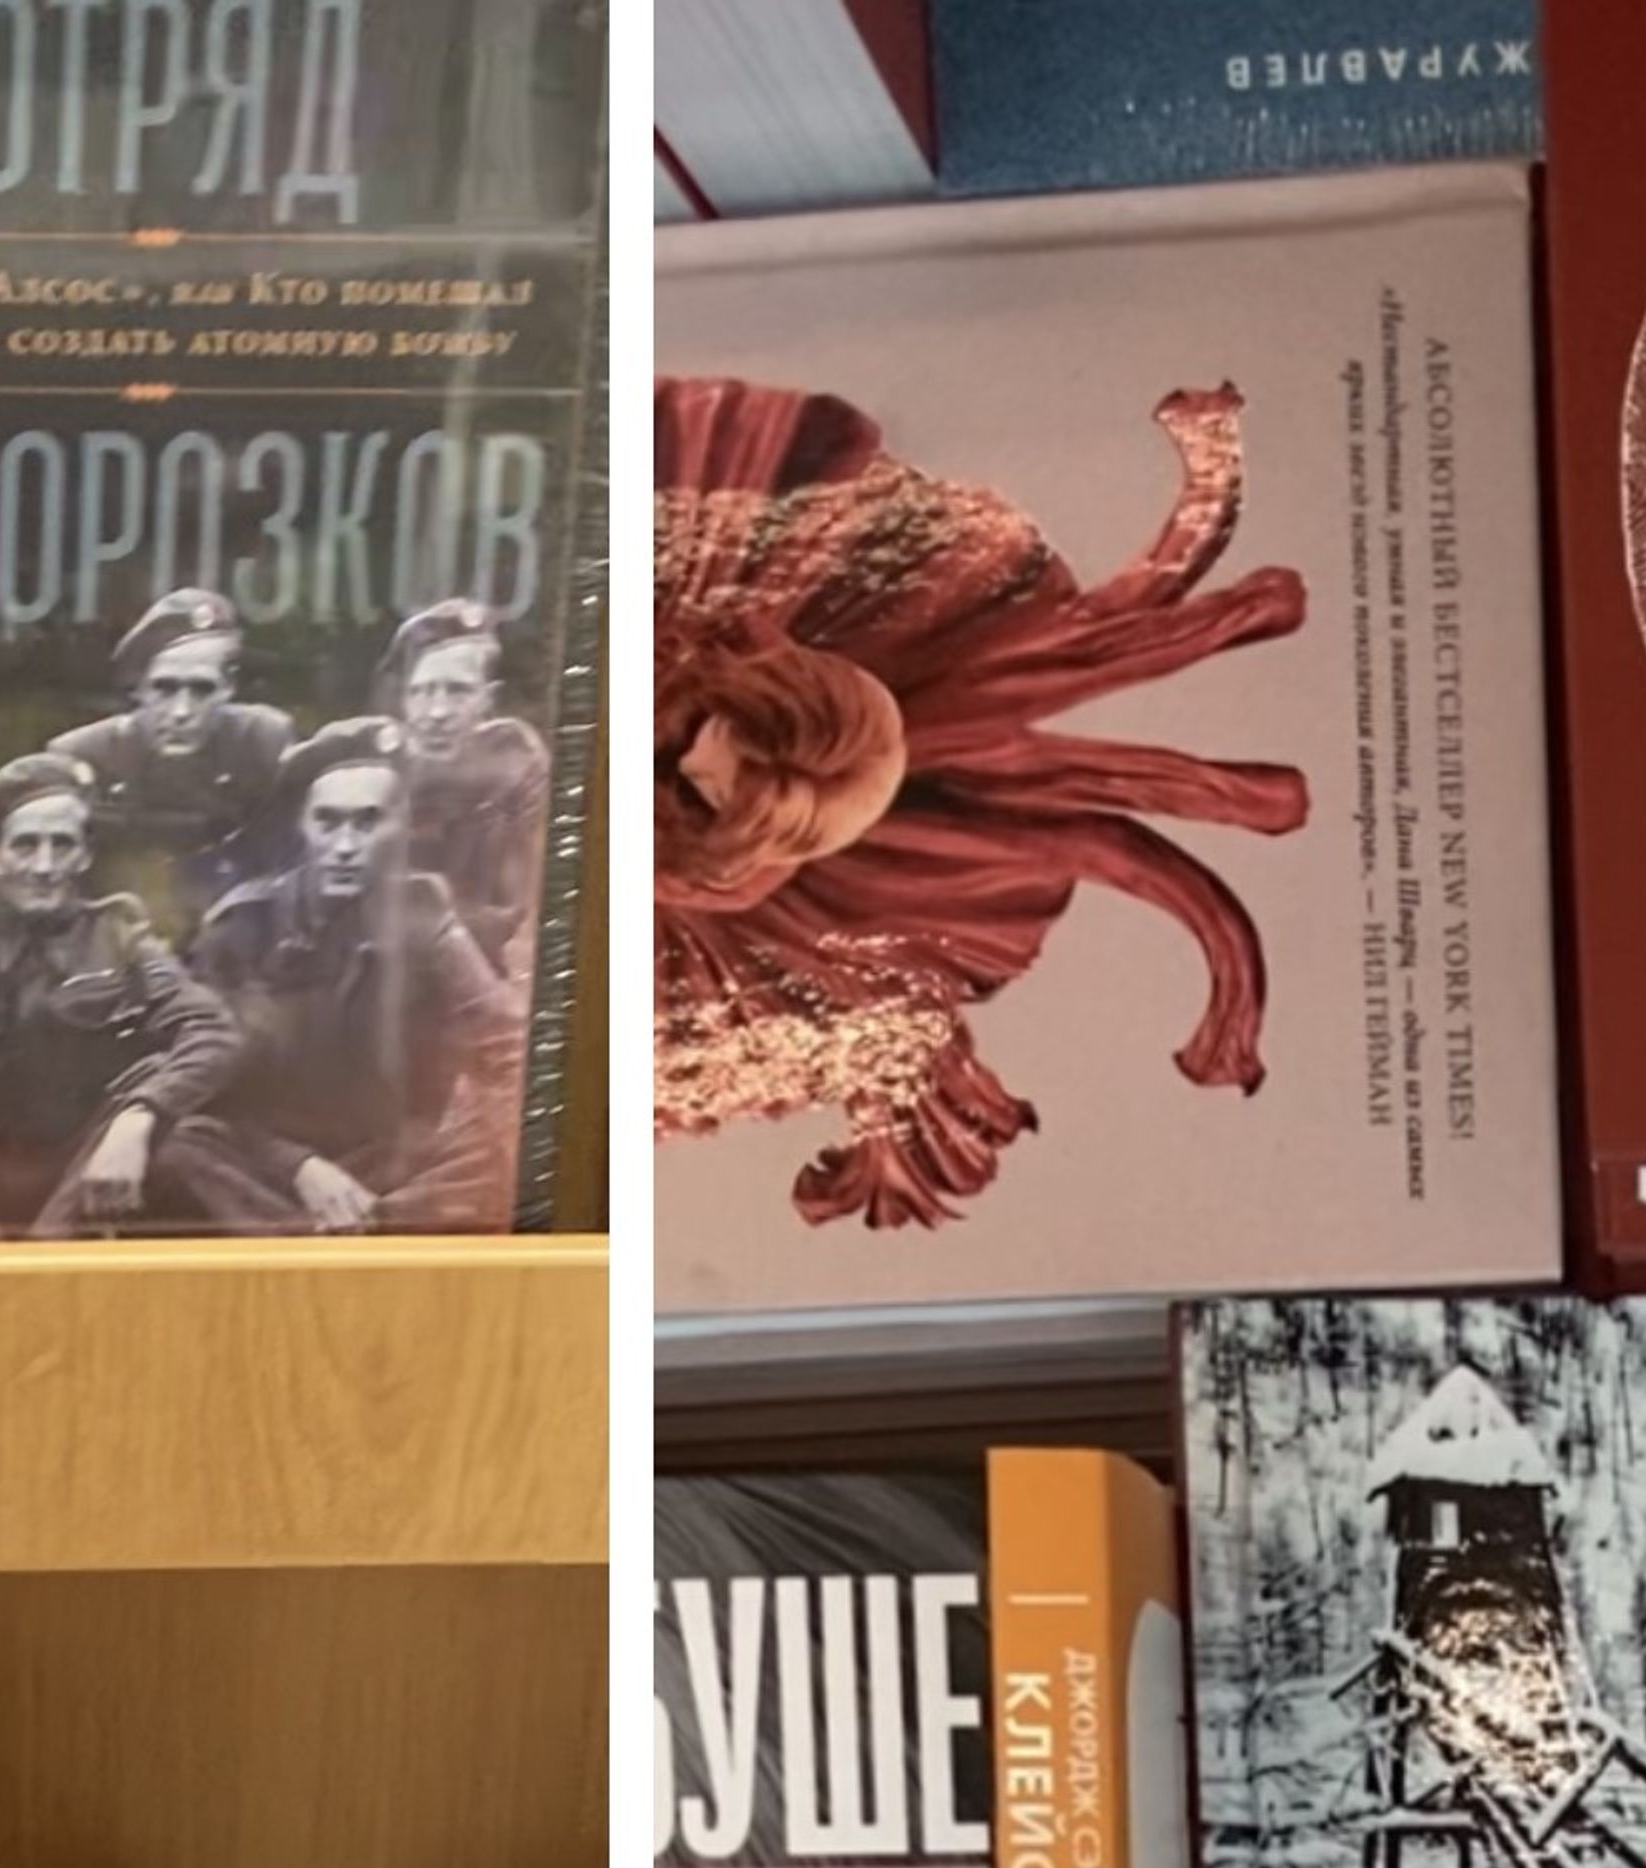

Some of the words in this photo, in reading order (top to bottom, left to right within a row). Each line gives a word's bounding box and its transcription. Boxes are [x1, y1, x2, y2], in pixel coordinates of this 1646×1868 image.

[1227, 40, 1531, 91] ЖУРАВЛЕВ
[1425, 336, 1462, 592] АБСОЛЮТНЫЙ
[1432, 600, 1465, 822] БЕСТСЕЛЛЕР
[1441, 829, 1468, 915] NEW
[1362, 920, 1387, 989] НИЛ
[1444, 920, 1471, 1019] YORK
[1365, 995, 1395, 1127] ГЕЙМАН
[1449, 1022, 1474, 1141] TIMES!
[654, 1572, 992, 1861] УШЕ
[1063, 1646, 1101, 1817] ДЖОРДЖ
